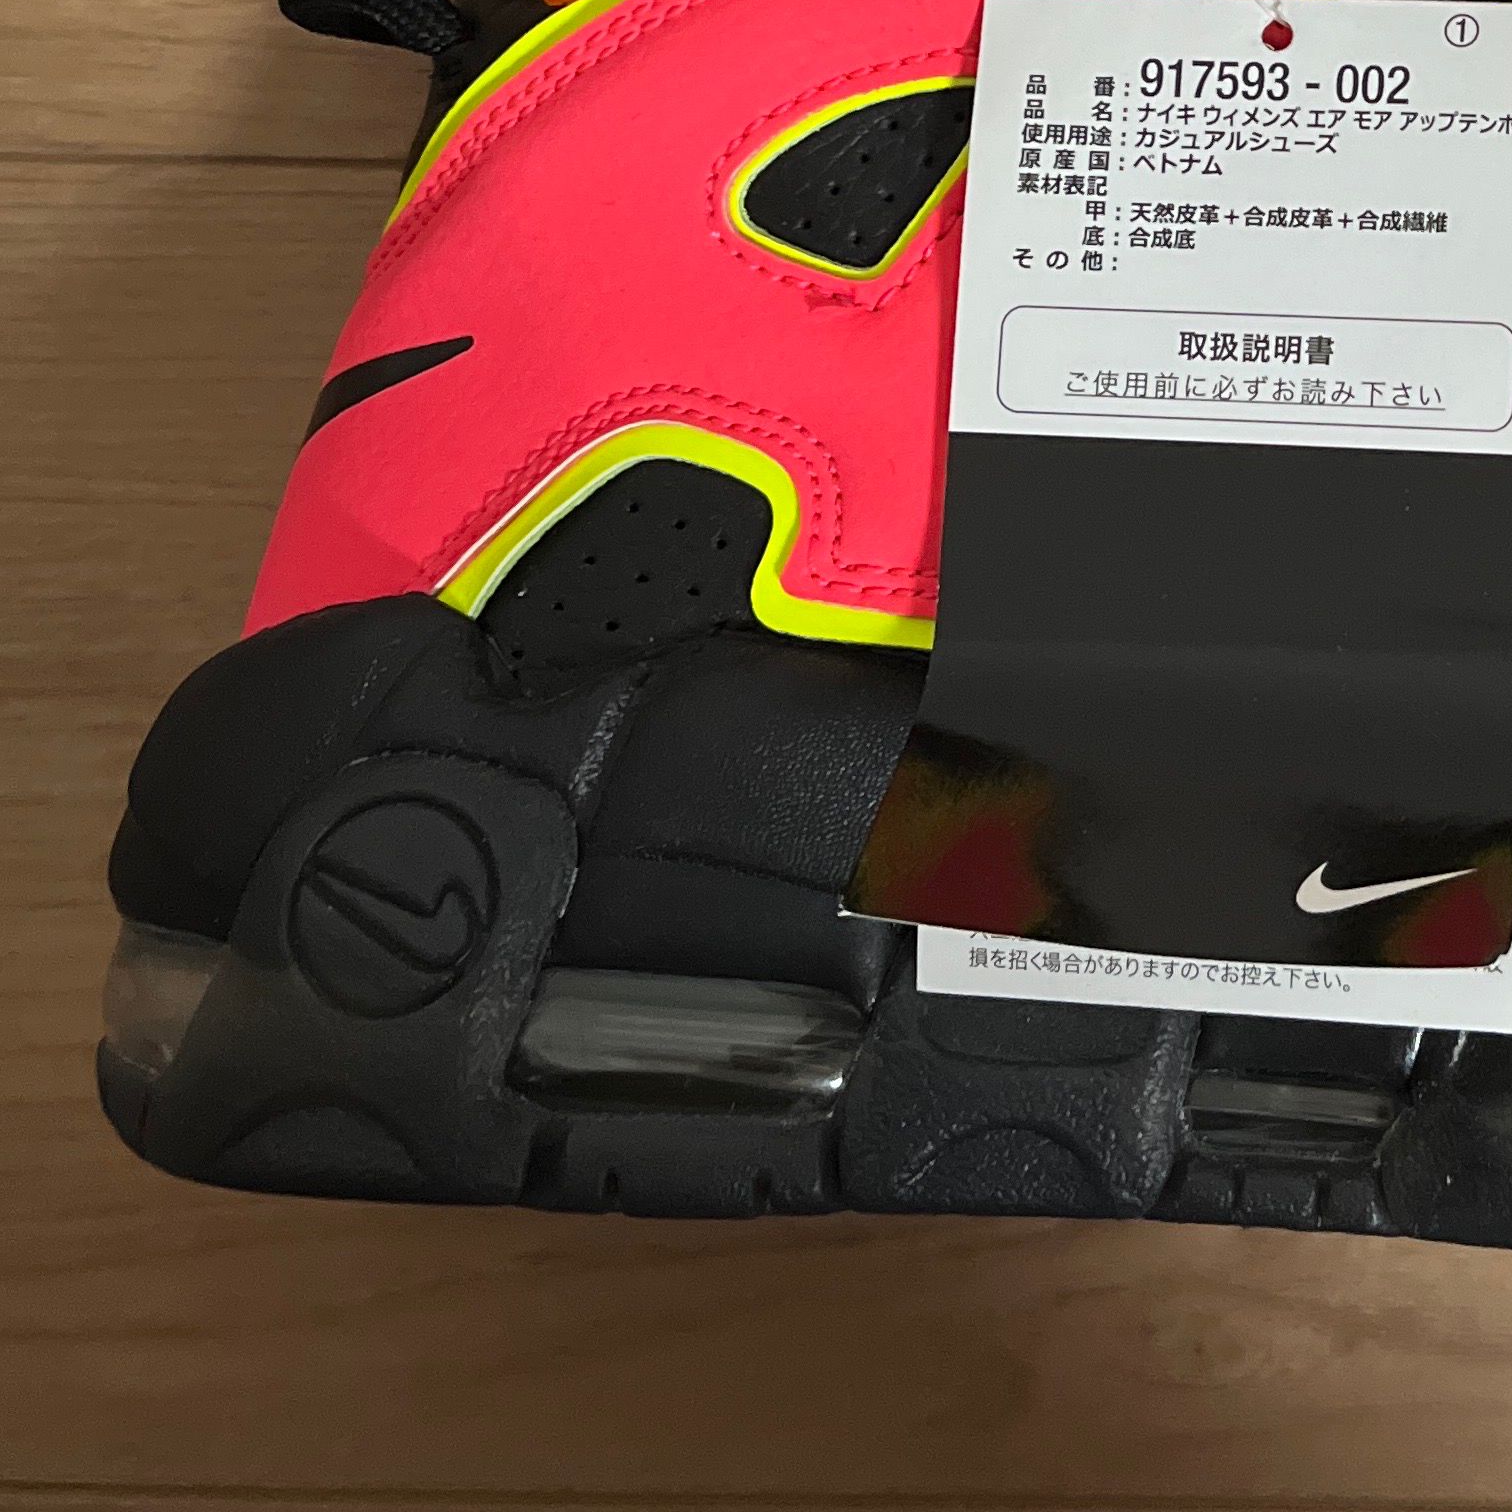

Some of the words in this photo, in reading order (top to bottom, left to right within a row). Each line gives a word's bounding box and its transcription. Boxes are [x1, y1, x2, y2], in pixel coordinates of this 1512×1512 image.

[1139, 58, 1291, 102] 917593
[1336, 64, 1411, 105] 002
[1017, 172, 1109, 197] 素材表記
[1177, 330, 1336, 366] 取扱説明書
[1065, 369, 1443, 407] ご使用前に必ずお読み下さい
